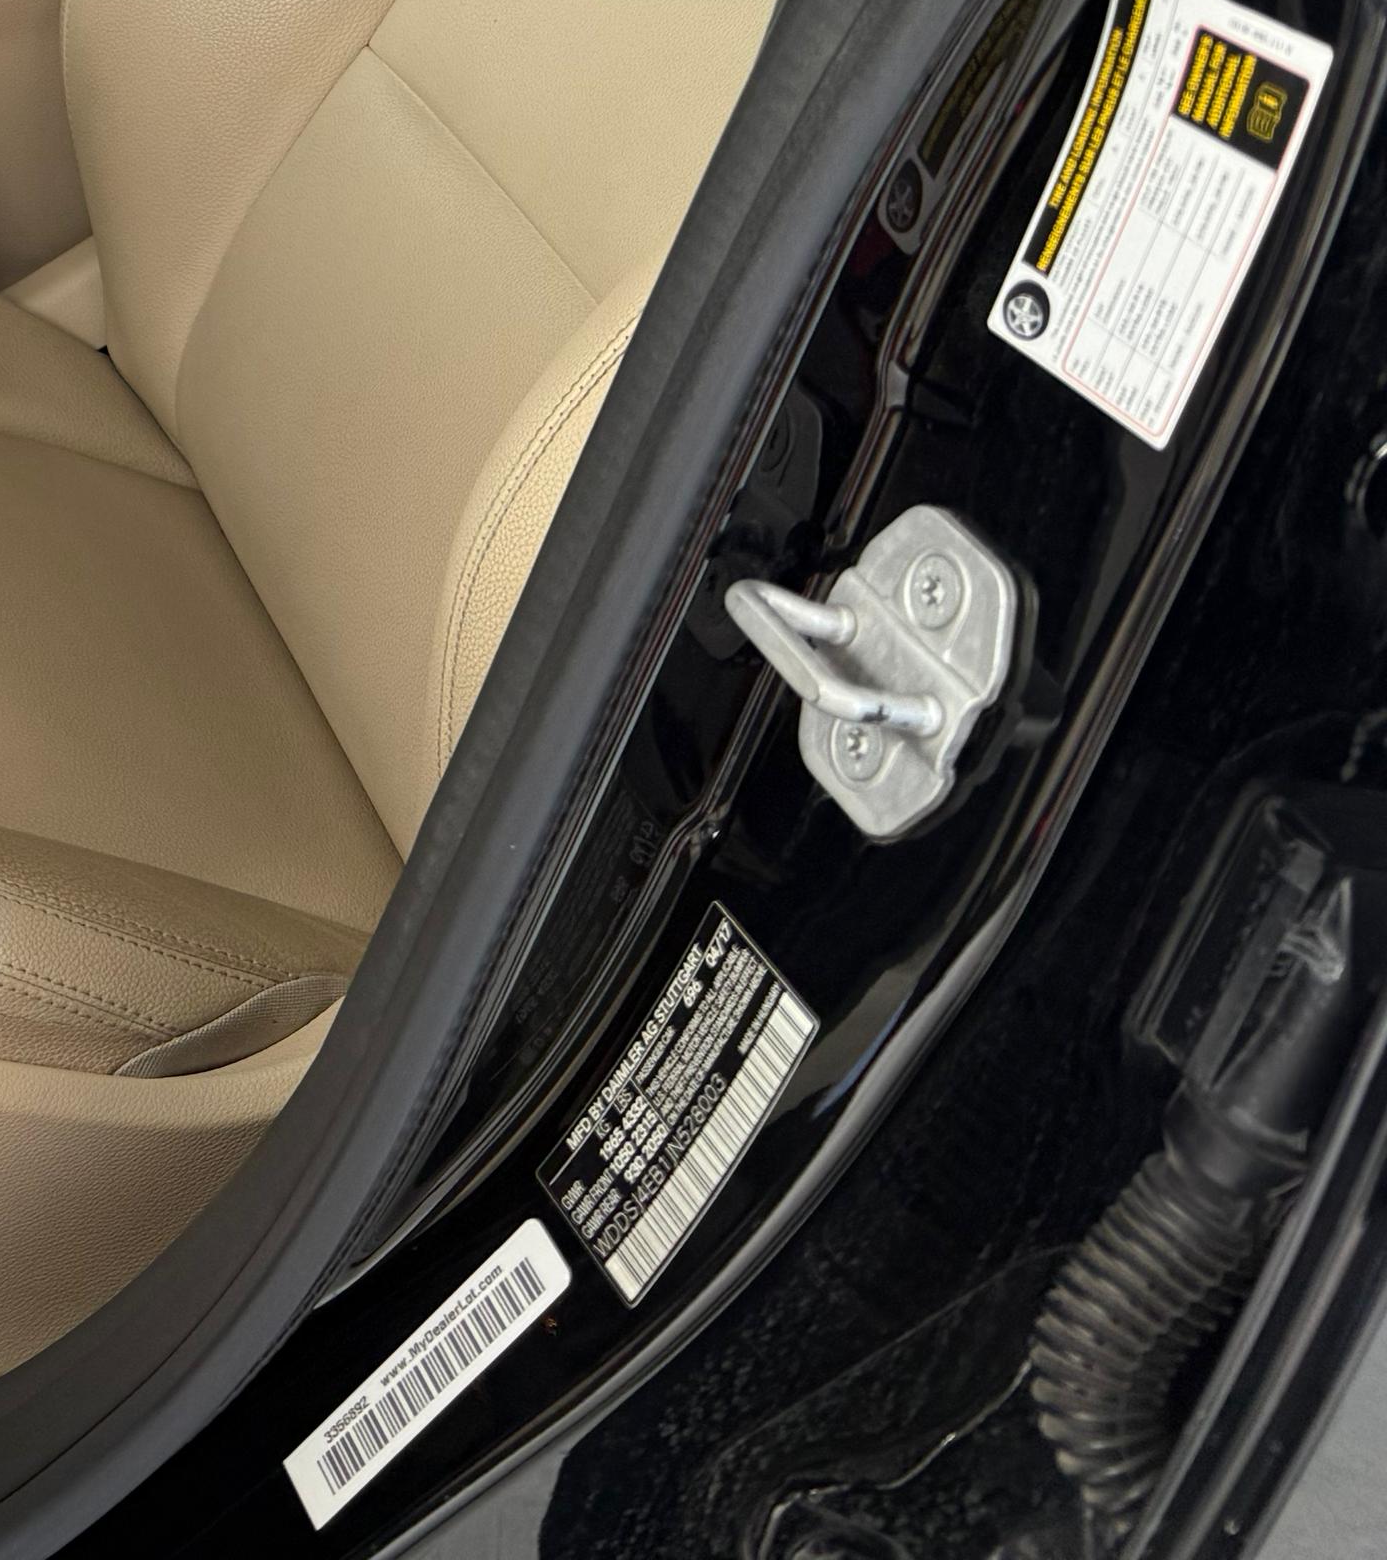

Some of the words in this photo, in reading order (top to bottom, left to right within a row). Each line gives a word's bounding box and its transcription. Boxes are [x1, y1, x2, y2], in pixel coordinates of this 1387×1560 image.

[566, 1115, 592, 1150] MFD
[588, 1097, 604, 1121] BY
[601, 1038, 645, 1103] DAIMLER
[640, 1017, 658, 1045] AG
[653, 941, 703, 1023] STUTTGART
[595, 1116, 611, 1139] KG
[613, 1086, 632, 1114] LBS
[704, 921, 733, 968] 04/17
[599, 1123, 625, 1163] 1965
[620, 1093, 647, 1133] 4332
[610, 1139, 635, 1176] 1050
[630, 1107, 656, 1147] 2315
[623, 1153, 646, 1186] 930
[641, 1122, 667, 1161] 2050
[323, 1394, 369, 1444] 3356892
[379, 1262, 503, 1389] www.MyDealerLot.com
